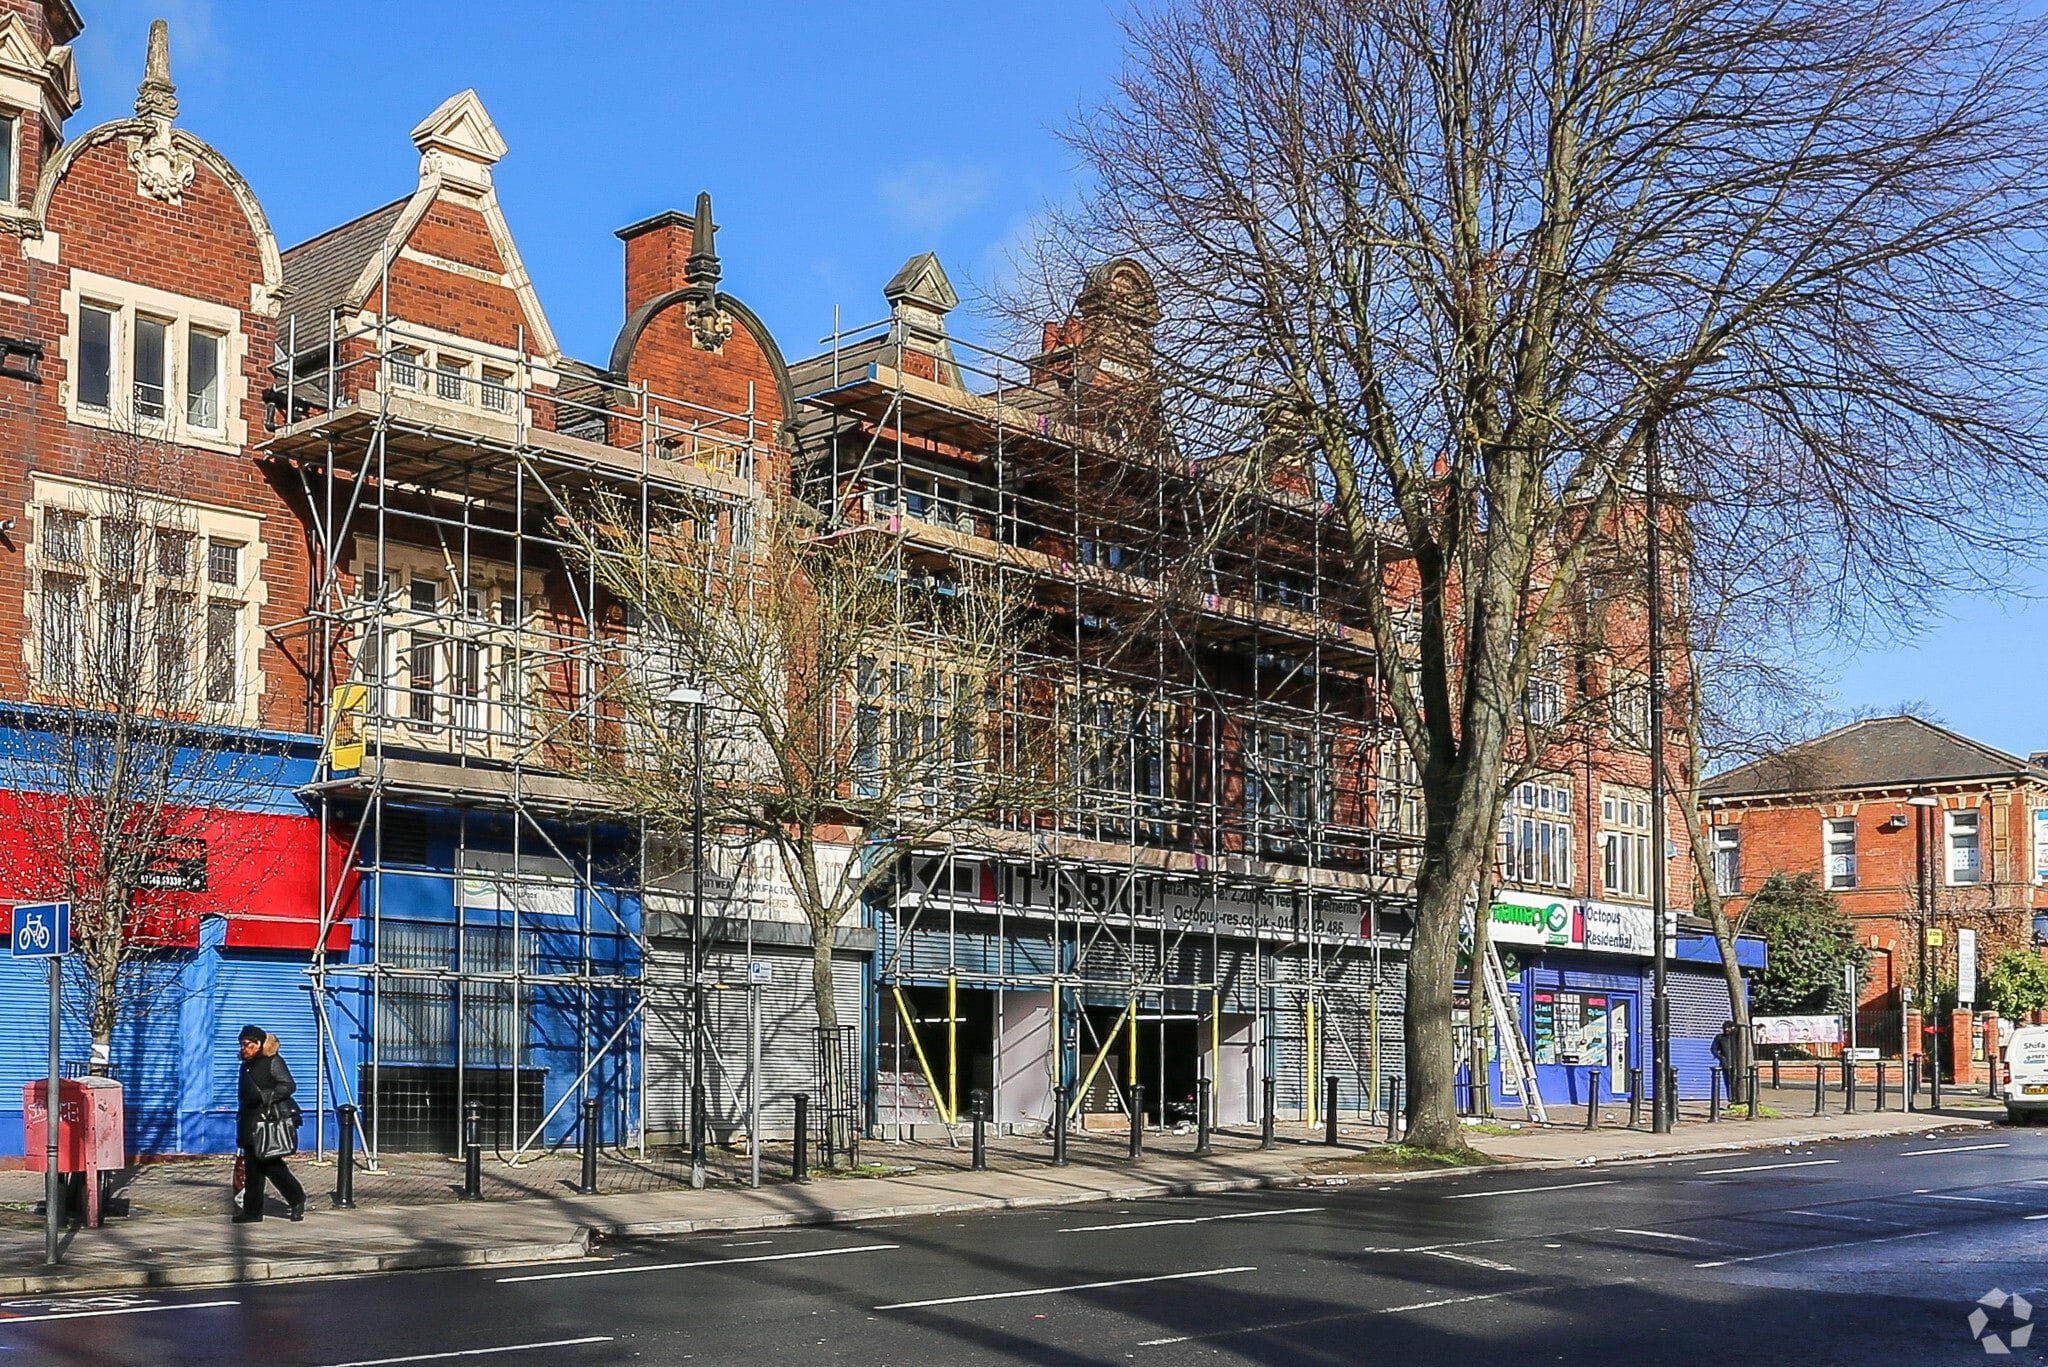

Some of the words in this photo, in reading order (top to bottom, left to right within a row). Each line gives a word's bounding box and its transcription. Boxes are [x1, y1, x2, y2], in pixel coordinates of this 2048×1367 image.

[1004, 865, 1073, 912] IT'S
[1083, 872, 1153, 918] BIG!
[1192, 882, 1228, 900] Spae:
[1276, 894, 1298, 908] fee
[1586, 906, 1620, 927] Octopus
[1586, 929, 1632, 948] Residential
[2023, 1042, 2046, 1050] Shifa
